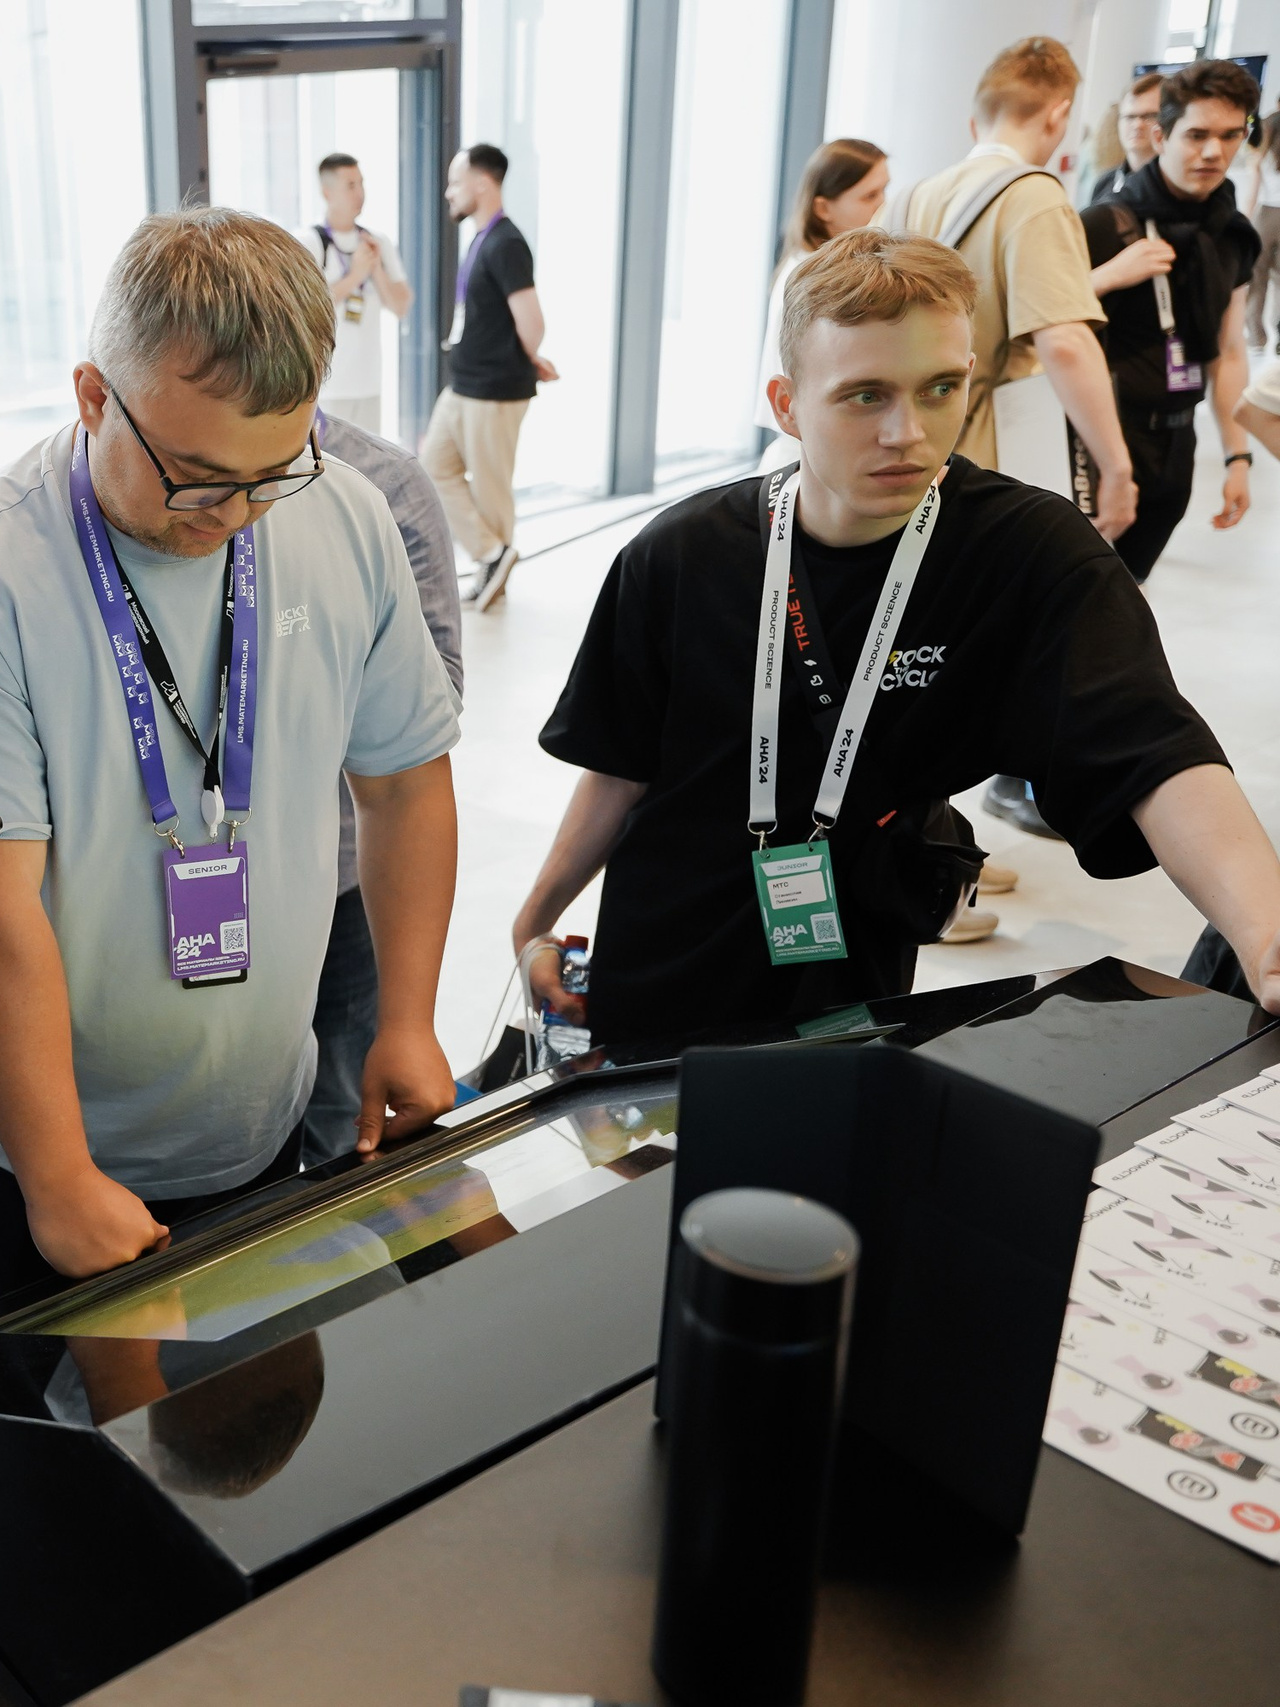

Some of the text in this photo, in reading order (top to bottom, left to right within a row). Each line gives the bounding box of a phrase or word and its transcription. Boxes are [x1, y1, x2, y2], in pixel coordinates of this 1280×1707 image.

[777, 491, 789, 541] AHA'24
[80, 497, 115, 603] LMS.MATEMARKETING.RU
[764, 590, 780, 690] PRODUCT SCIENCE
[787, 599, 810, 652] TRUE
[863, 581, 903, 681] PRODUCT SCIENCE
[237, 639, 250, 743] LMS.MATEMARKETING.RU
[758, 735, 769, 784] AHA'24
[834, 728, 854, 778] AHA'24
[188, 864, 228, 875] SENIOR
[177, 933, 216, 948] AHA
[772, 923, 808, 938] AHA
